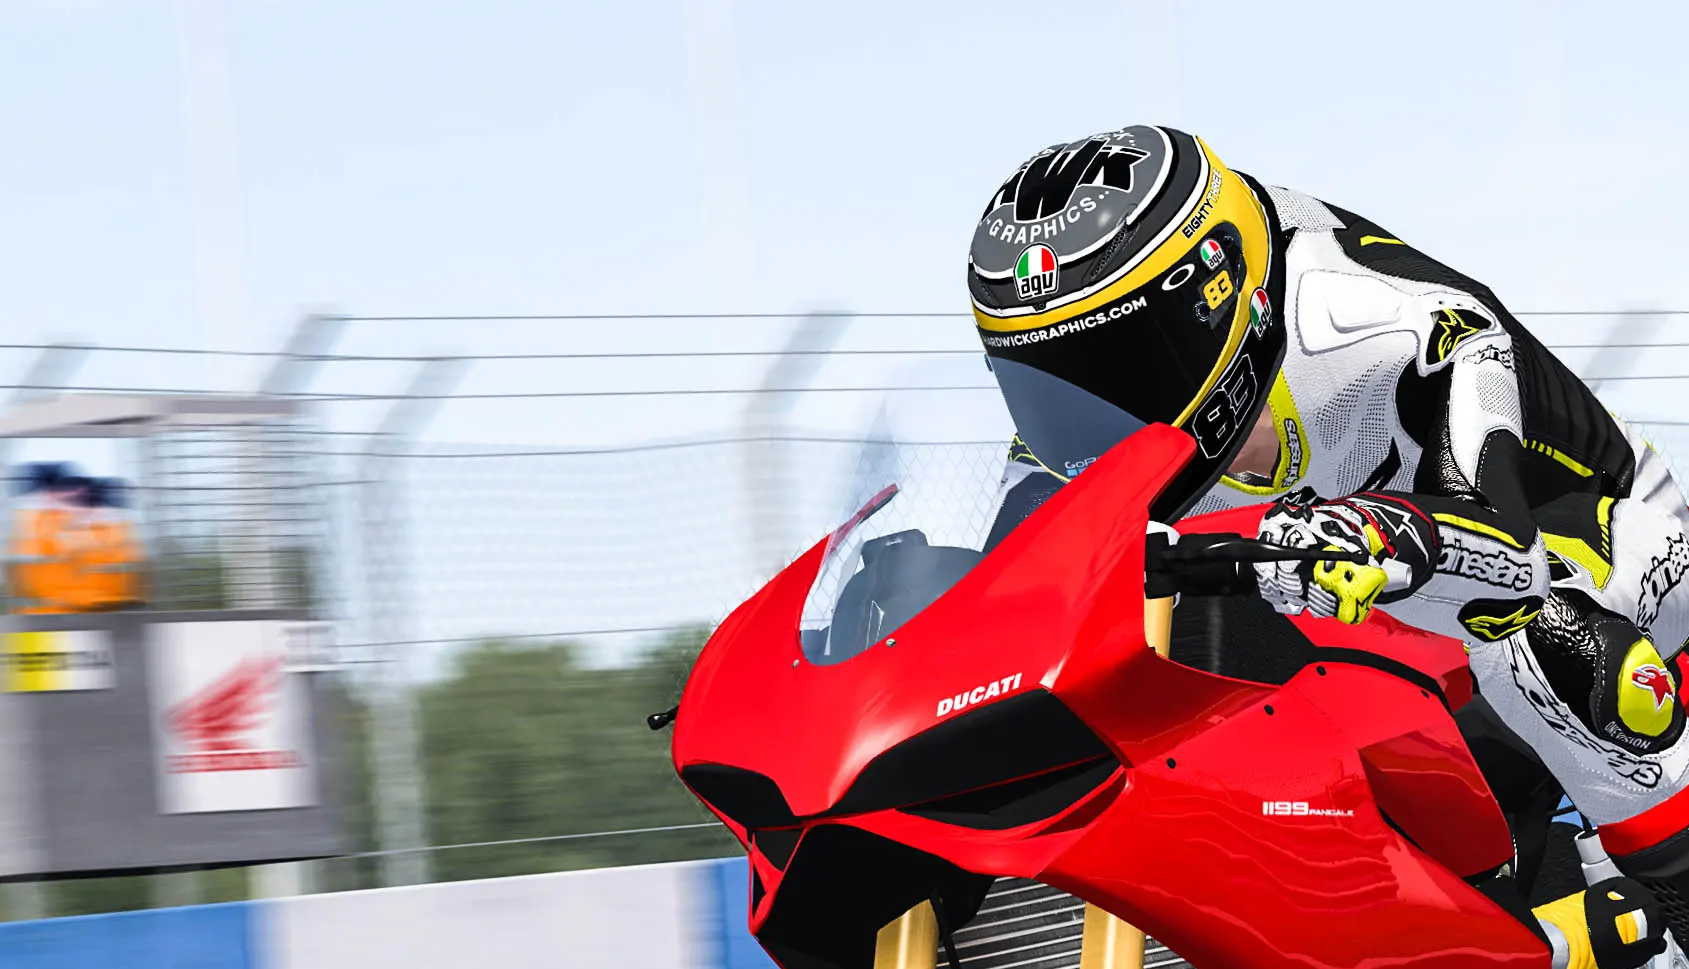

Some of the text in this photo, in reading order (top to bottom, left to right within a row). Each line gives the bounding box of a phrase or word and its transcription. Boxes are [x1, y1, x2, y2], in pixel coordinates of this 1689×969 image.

[988, 196, 1097, 245] GRAPHICS
[1020, 271, 1054, 296] agv
[1203, 270, 1234, 310] 83
[1192, 354, 1258, 459] 83
[936, 672, 1023, 717] DUCATI
[1262, 801, 1309, 816] 1199
